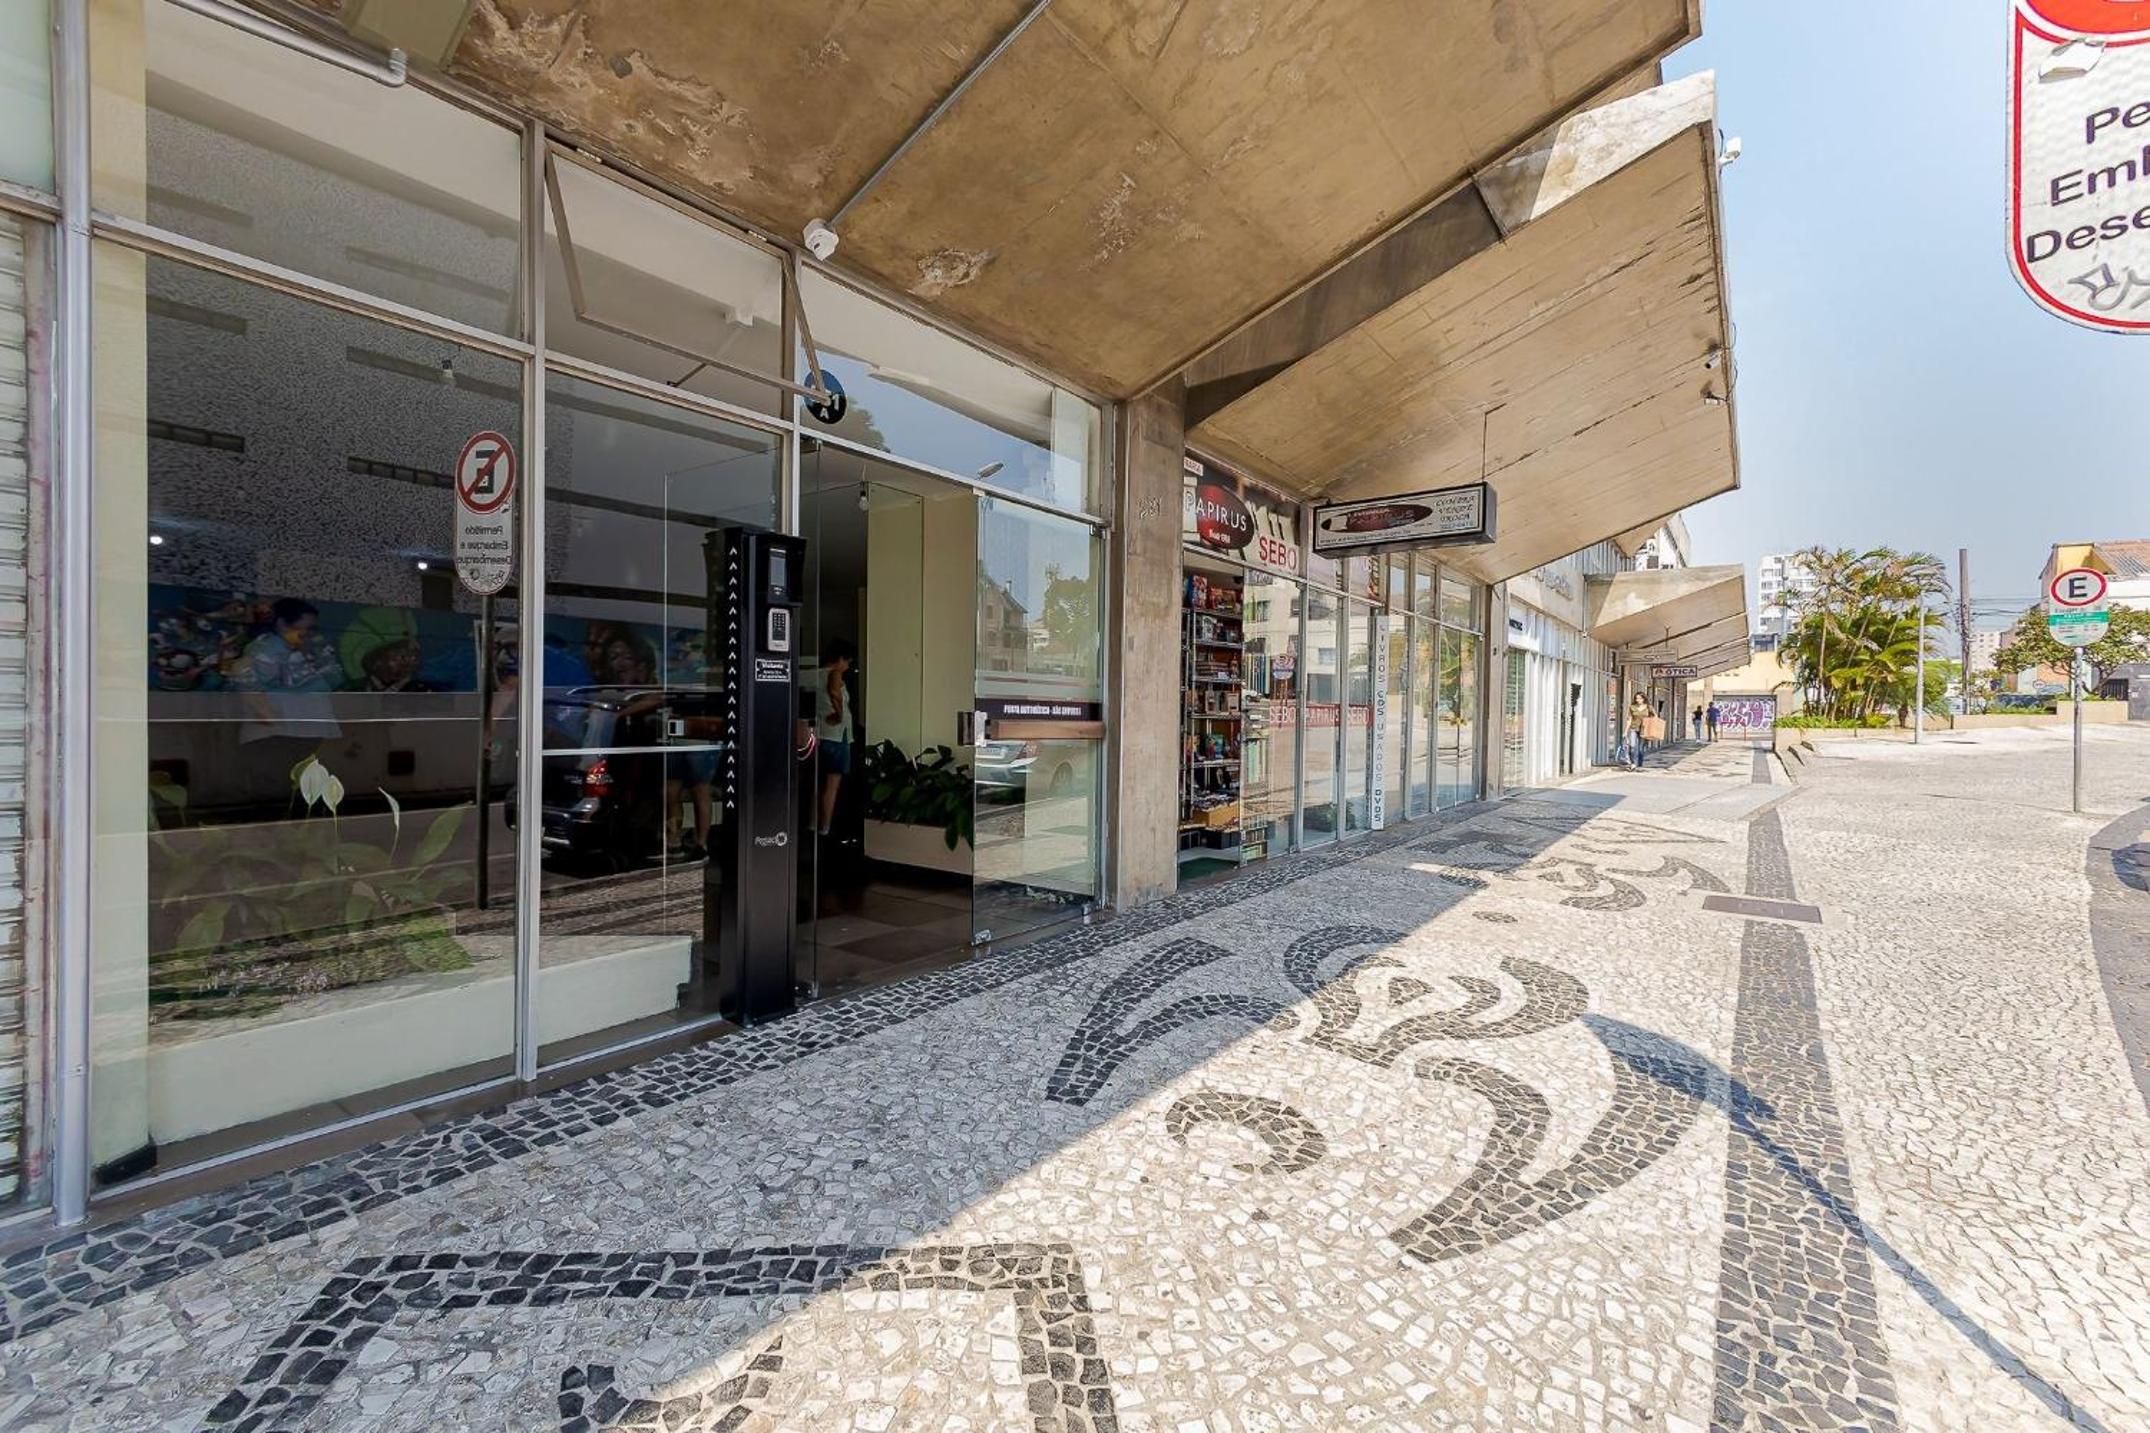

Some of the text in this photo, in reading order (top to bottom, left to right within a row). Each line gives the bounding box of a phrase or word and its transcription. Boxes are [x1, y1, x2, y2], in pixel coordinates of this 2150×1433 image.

[1185, 490, 1247, 532] PAPIRUS
[1259, 535, 1298, 571] SEBO
[2069, 576, 2088, 598] E
[1269, 705, 1297, 724] SEBO
